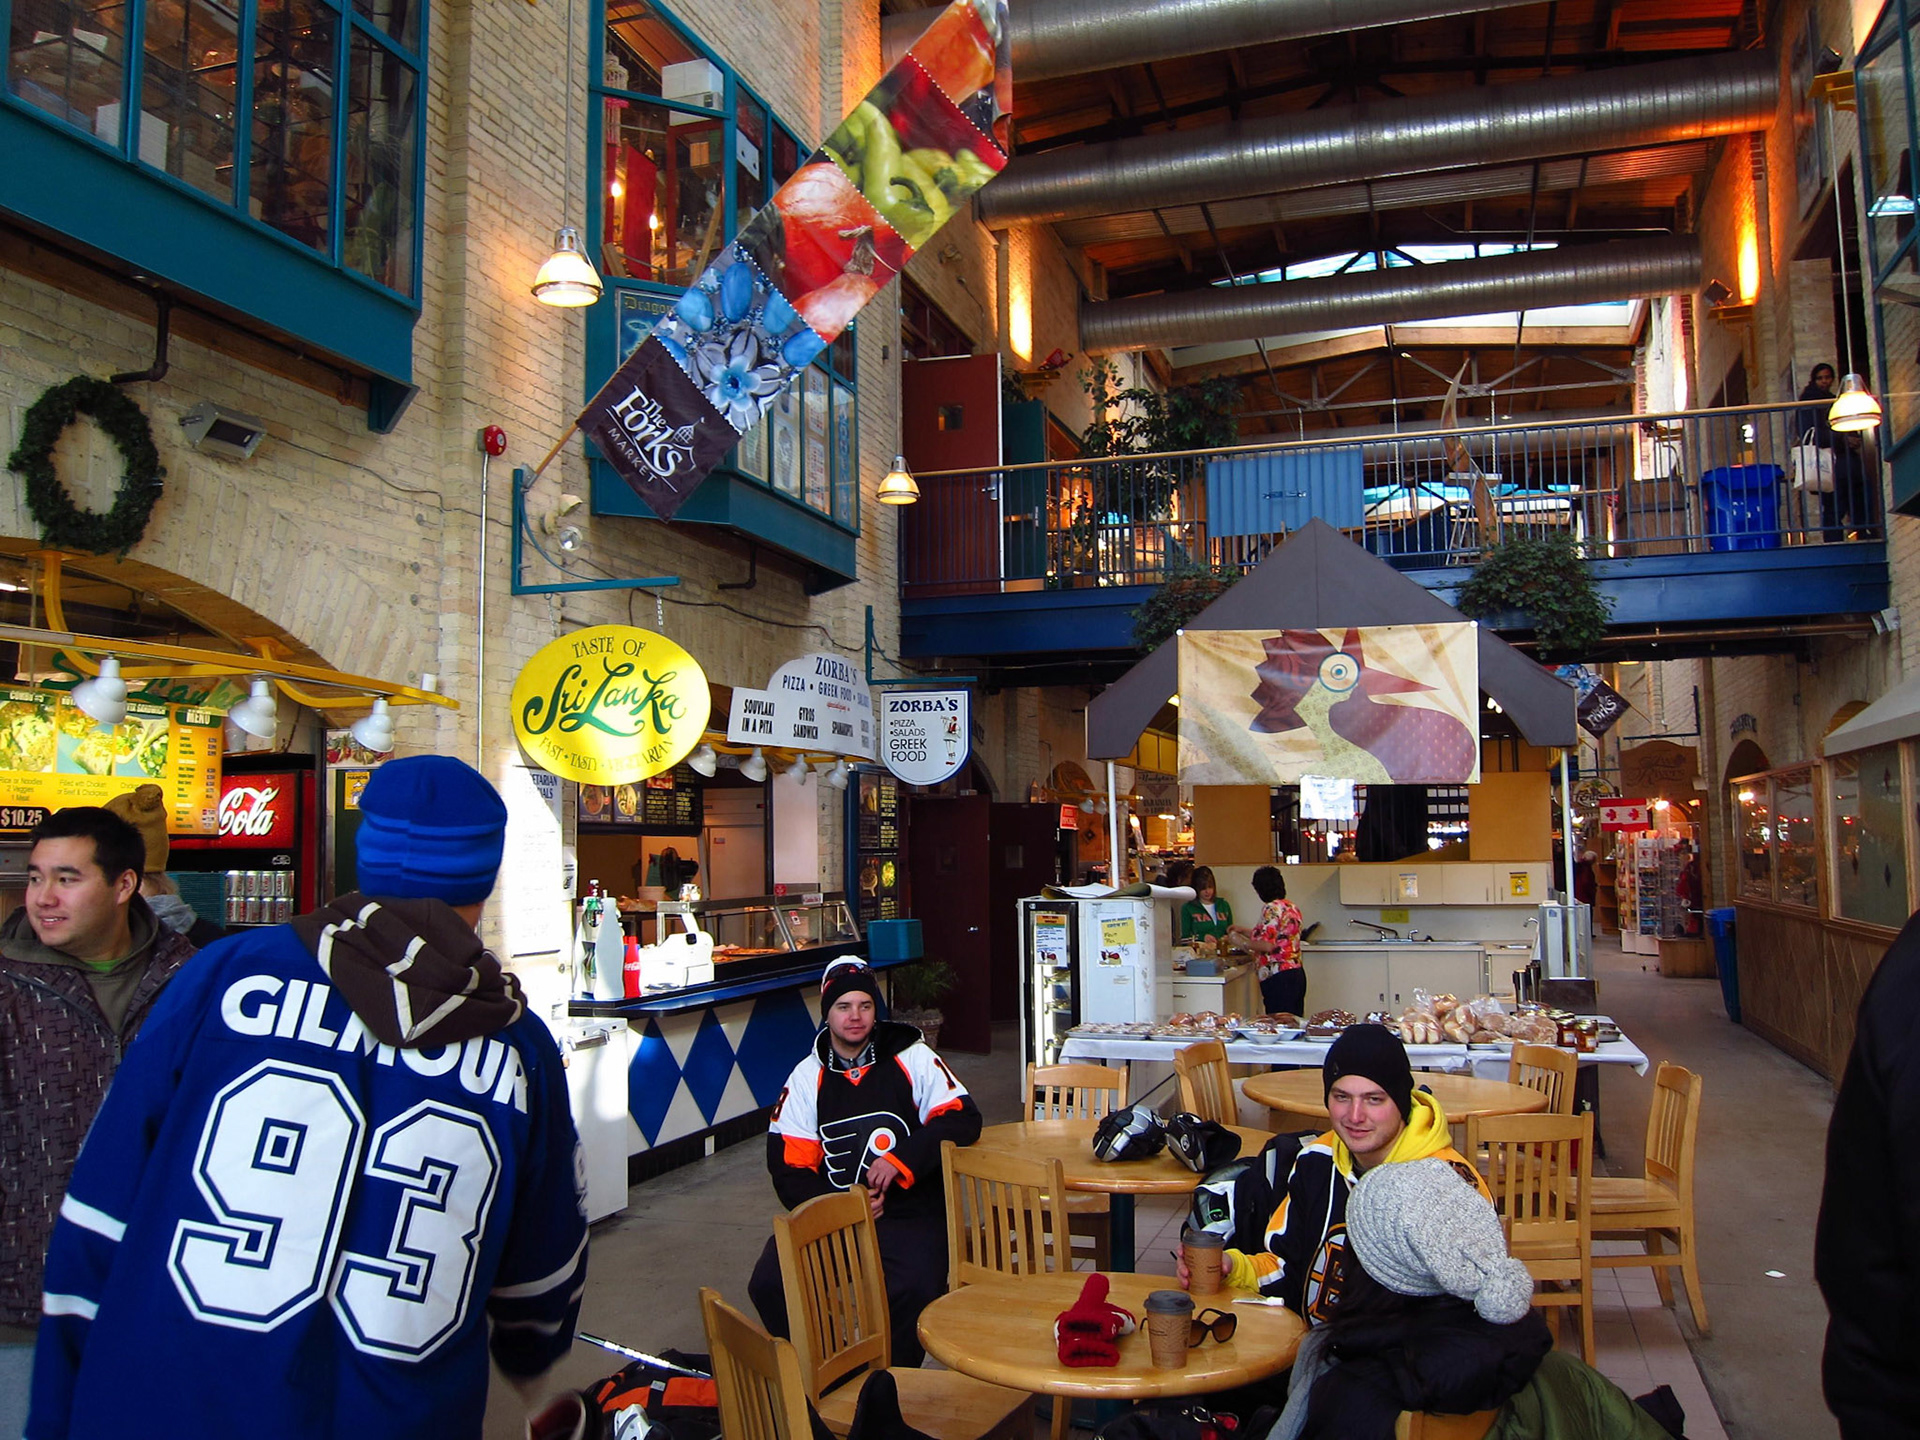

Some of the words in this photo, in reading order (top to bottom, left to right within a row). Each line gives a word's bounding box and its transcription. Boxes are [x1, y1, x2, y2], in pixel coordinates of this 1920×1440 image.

[644, 398, 667, 428] The
[611, 384, 683, 477] Forks
[607, 427, 658, 483] MARKET
[572, 637, 614, 658] TASTE
[623, 639, 646, 657] OF
[815, 657, 857, 685] ZORBA'S
[523, 664, 588, 734] Sri
[559, 656, 686, 737] Lanka
[782, 675, 805, 692] PIZZA
[818, 682, 838, 699] GREEK
[744, 699, 775, 716] SOUVLAKI
[798, 707, 815, 722] GYROS
[890, 697, 958, 712] ZORBA'S
[186, 709, 211, 724] MENU
[742, 718, 750, 731] IN
[752, 719, 757, 732] A
[759, 719, 773, 734] PITA
[793, 724, 818, 739] SANDWICH
[893, 728, 926, 737] SALADS
[539, 736, 564, 760] FAST
[890, 738, 927, 750] GREEK
[891, 751, 927, 762] FOOD
[1, 808, 43, 827] $10.25
[219, 787, 279, 836] Cola
[167, 1058, 501, 1363] 93
